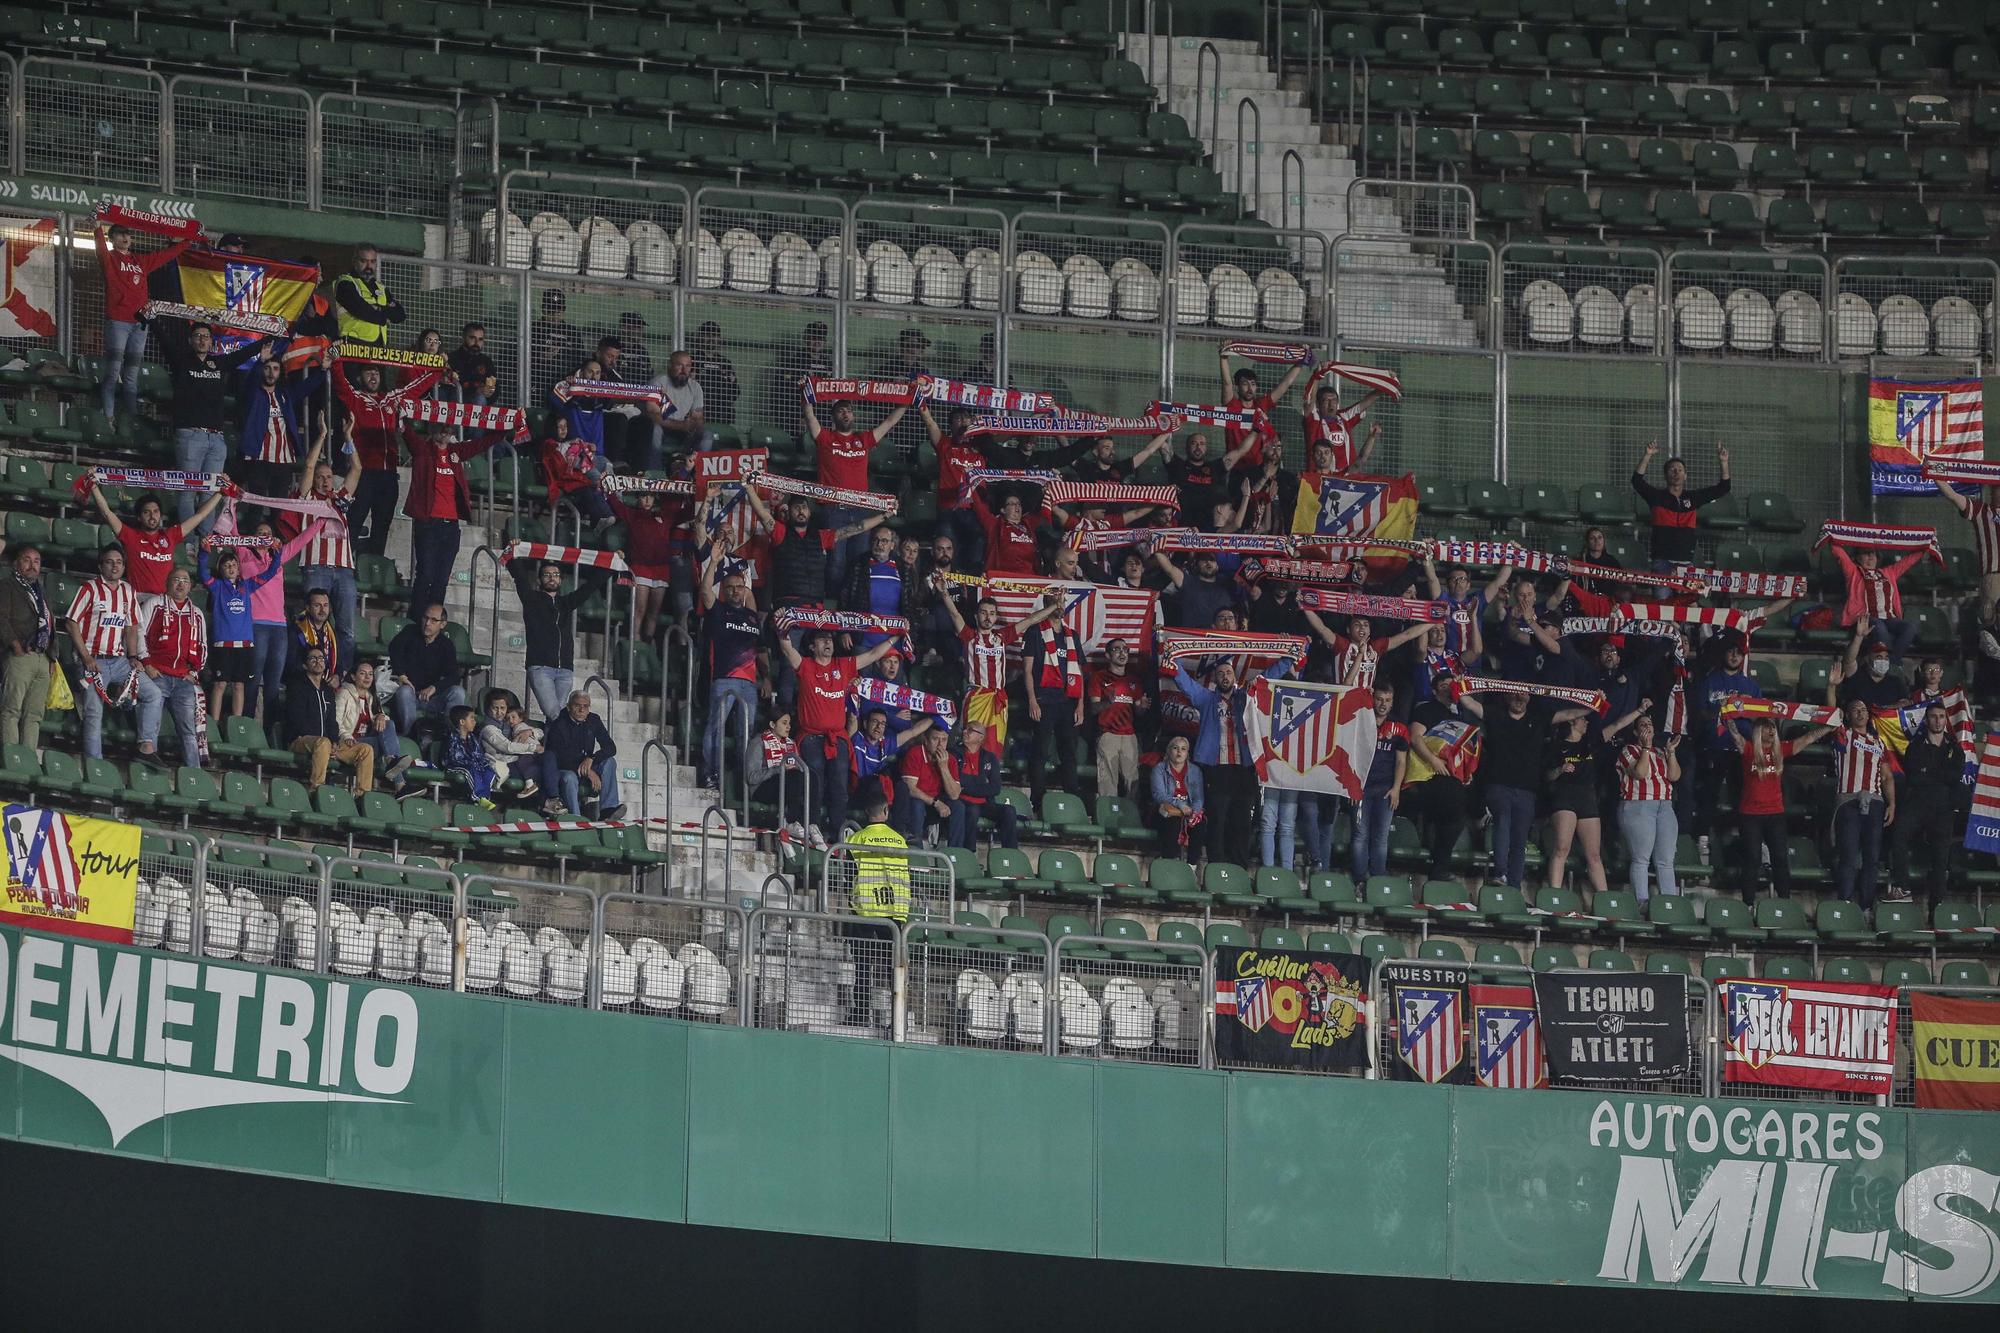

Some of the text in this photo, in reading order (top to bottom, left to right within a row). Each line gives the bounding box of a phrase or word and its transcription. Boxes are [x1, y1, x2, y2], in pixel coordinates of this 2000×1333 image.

[31, 184, 90, 206] SALIDA
[150, 214, 160, 224] DE
[160, 216, 187, 229] MADRID
[340, 343, 370, 358] NUNCA
[371, 347, 401, 361] DEJES
[402, 349, 415, 363] DE
[873, 381, 909, 396] MADRID
[981, 414, 1095, 431] TE QUIERO ATLETI
[1212, 412, 1243, 422] MADRID
[702, 454, 766, 476] NO SE
[167, 472, 211, 481] MADRID
[1229, 535, 1267, 549] Madrid
[1292, 575, 1342, 584] MADRID
[1734, 575, 1746, 588] DE
[1747, 577, 1788, 592] MADRID
[102, 614, 125, 626] mita
[797, 611, 820, 622] CLUB
[862, 616, 873, 626] DE
[874, 617, 906, 628] MADRI
[512, 637, 523, 646] 07
[1225, 641, 1238, 650] DE
[1242, 640, 1288, 650] MADRID
[1470, 680, 1487, 691] THE
[1570, 690, 1595, 704] FANS
[626, 769, 637, 779] 05
[81, 841, 139, 880] tour
[1236, 951, 1310, 981] Cuéllar
[1388, 968, 1468, 985] NUESTRO
[1564, 985, 1655, 1014] TECHNO
[0, 925, 420, 1097] EMETRIO
[1291, 1018, 1336, 1050] Lads
[1748, 997, 1889, 1063] SECC. LEVANTE
[1589, 1100, 1884, 1161] AUTOGARES
